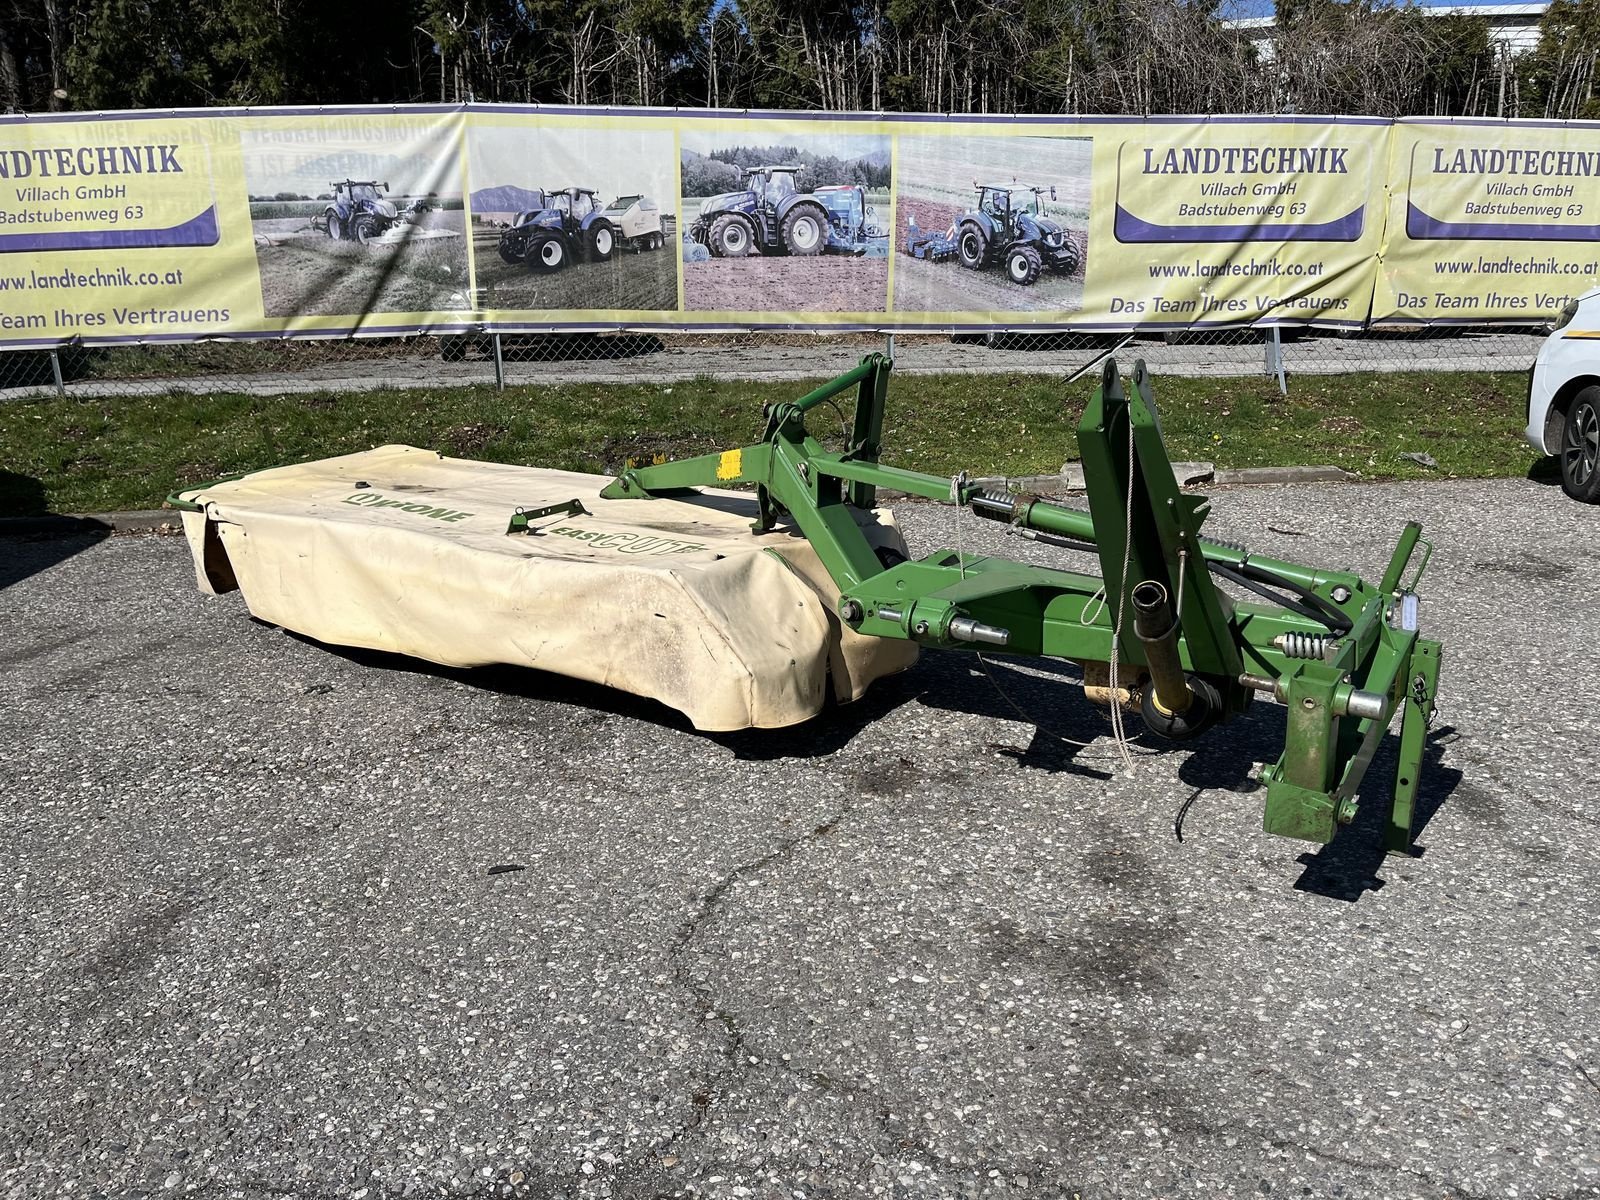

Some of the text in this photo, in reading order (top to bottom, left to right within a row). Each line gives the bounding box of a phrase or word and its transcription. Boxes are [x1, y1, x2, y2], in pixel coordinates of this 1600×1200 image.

[1142, 147, 1348, 174] LANDTECHNIK
[16, 186, 69, 202] Villach
[76, 184, 126, 199] GmbH
[1200, 182, 1297, 196] Villach GmbH
[1486, 183, 1574, 197] Villach GmbH
[0, 205, 144, 224] Badstubenweg 63
[1178, 203, 1307, 218] Badstubenweg 63
[1465, 203, 1583, 219] Badstubenweg 63
[1149, 259, 1323, 278] www.landtechnik.co.at
[1434, 256, 1598, 275] www.landtechnik.co.at
[1110, 295, 1349, 313] Das Team Ihres Vetrauens
[1397, 293, 1428, 309] Das
[1434, 293, 1479, 309] Team
[1485, 292, 1529, 309] Ihres
[0, 307, 230, 329] eam Ihres Vertrauens
